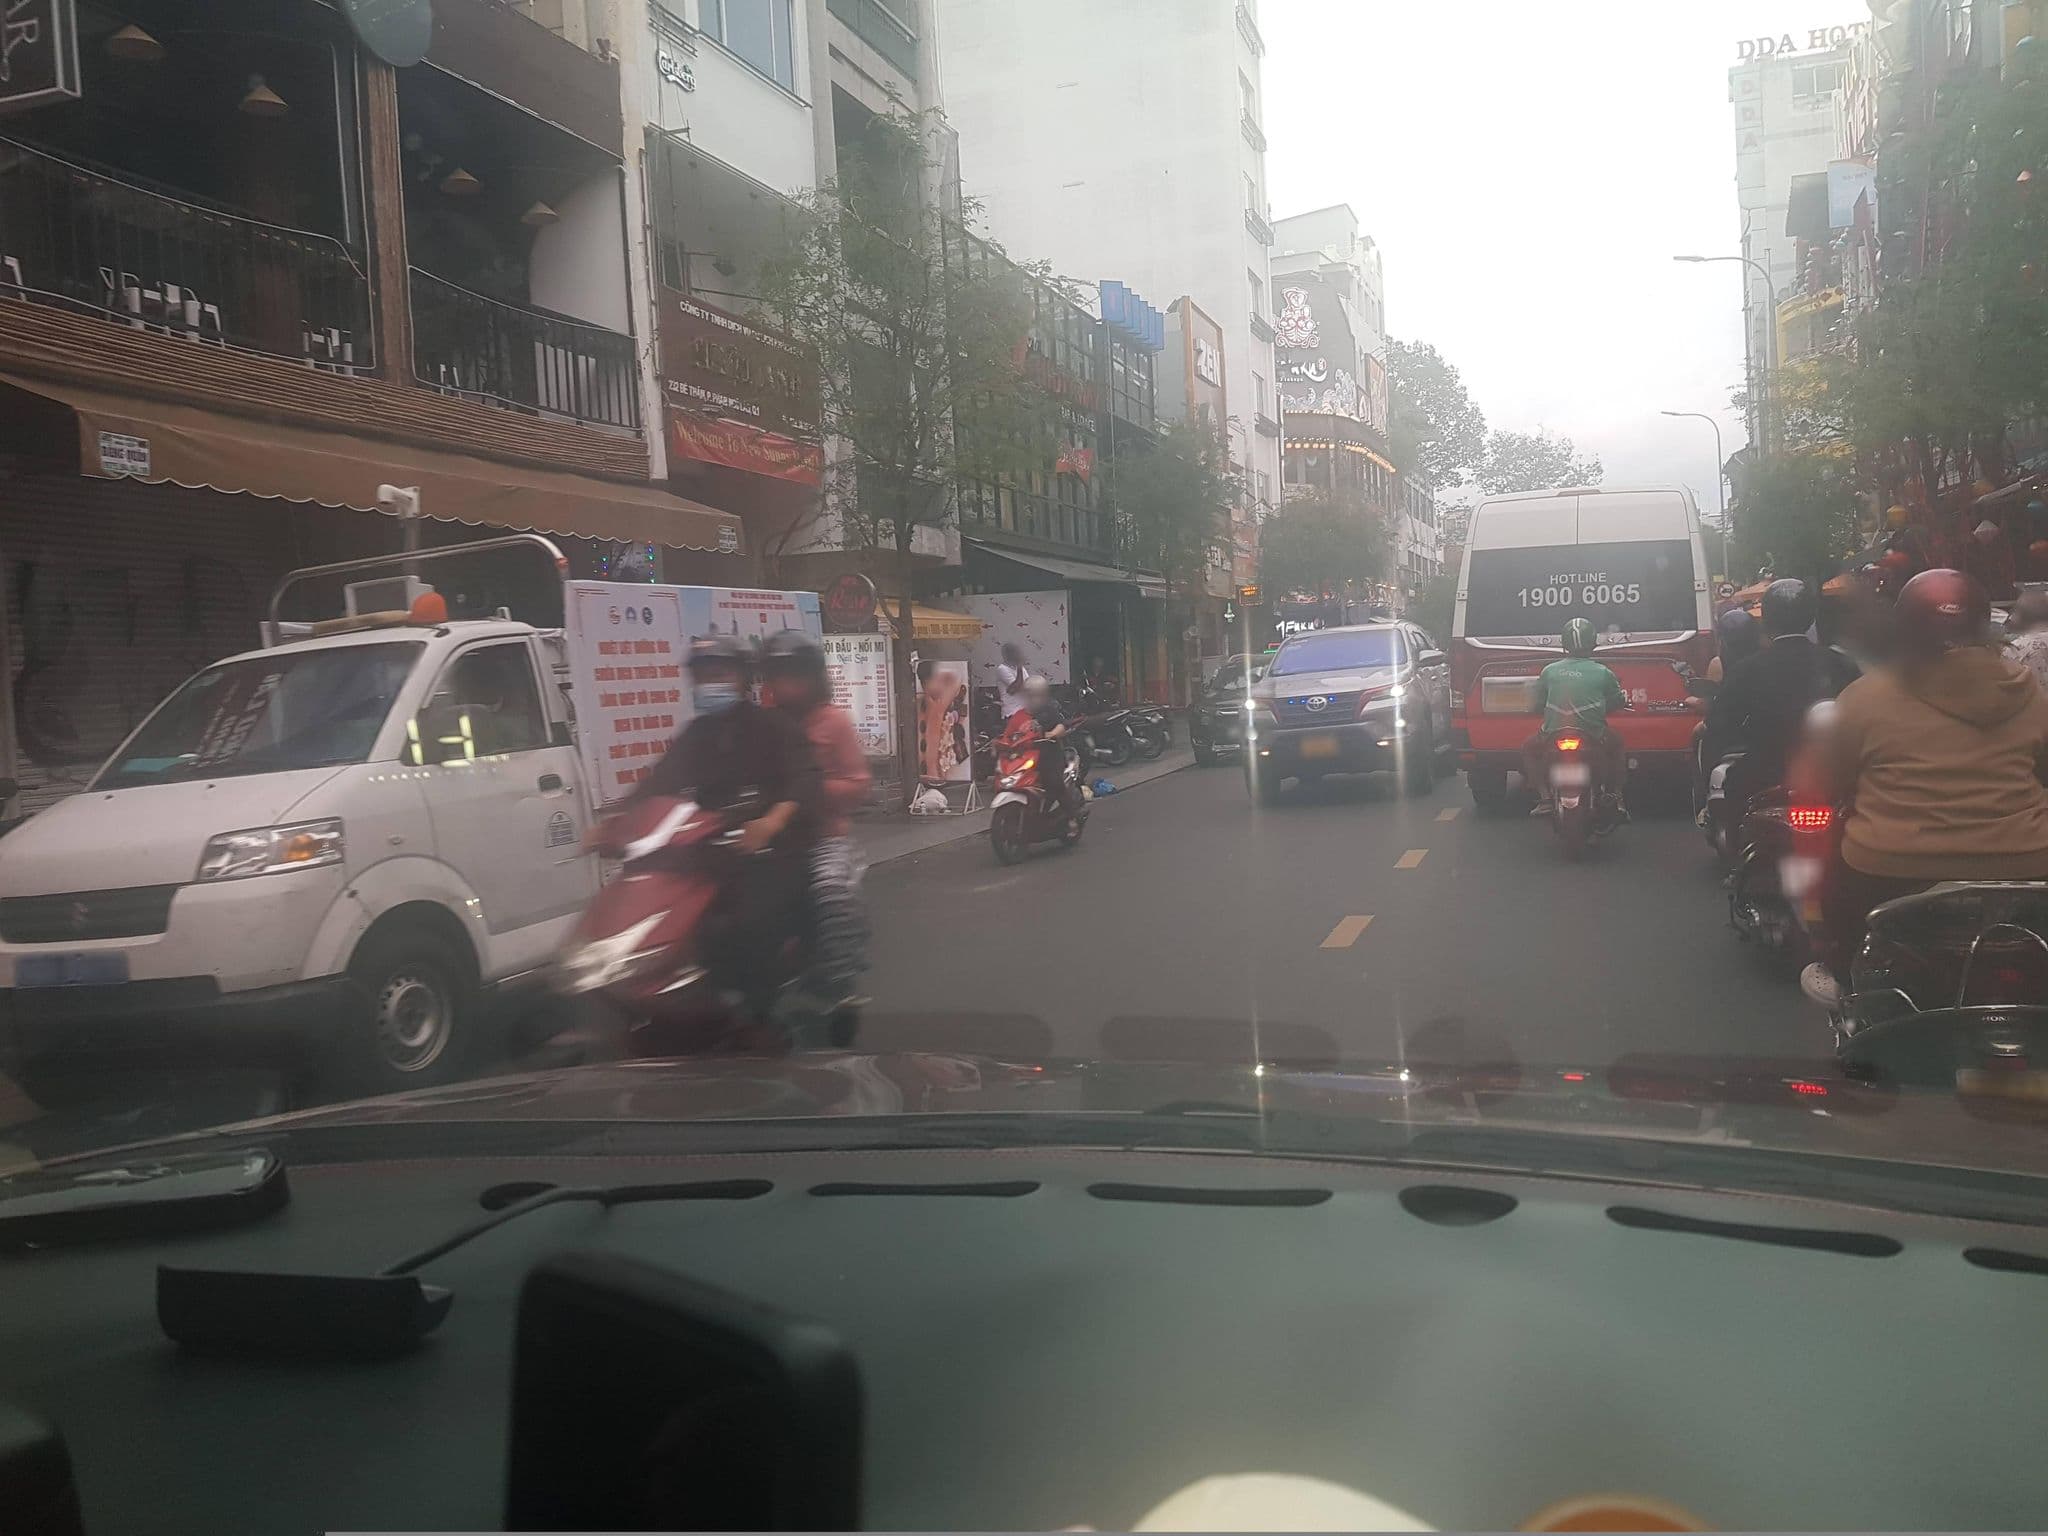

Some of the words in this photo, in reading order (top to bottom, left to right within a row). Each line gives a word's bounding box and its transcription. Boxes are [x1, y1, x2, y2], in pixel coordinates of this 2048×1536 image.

[1736, 33, 1797, 59] DDA
[674, 420, 724, 450] Welcome
[725, 432, 738, 453] To
[1550, 572, 1607, 585] HOTLINE
[1518, 586, 1573, 608] 1900
[1582, 584, 1640, 605] 6065
[1559, 668, 1583, 678] Grab
